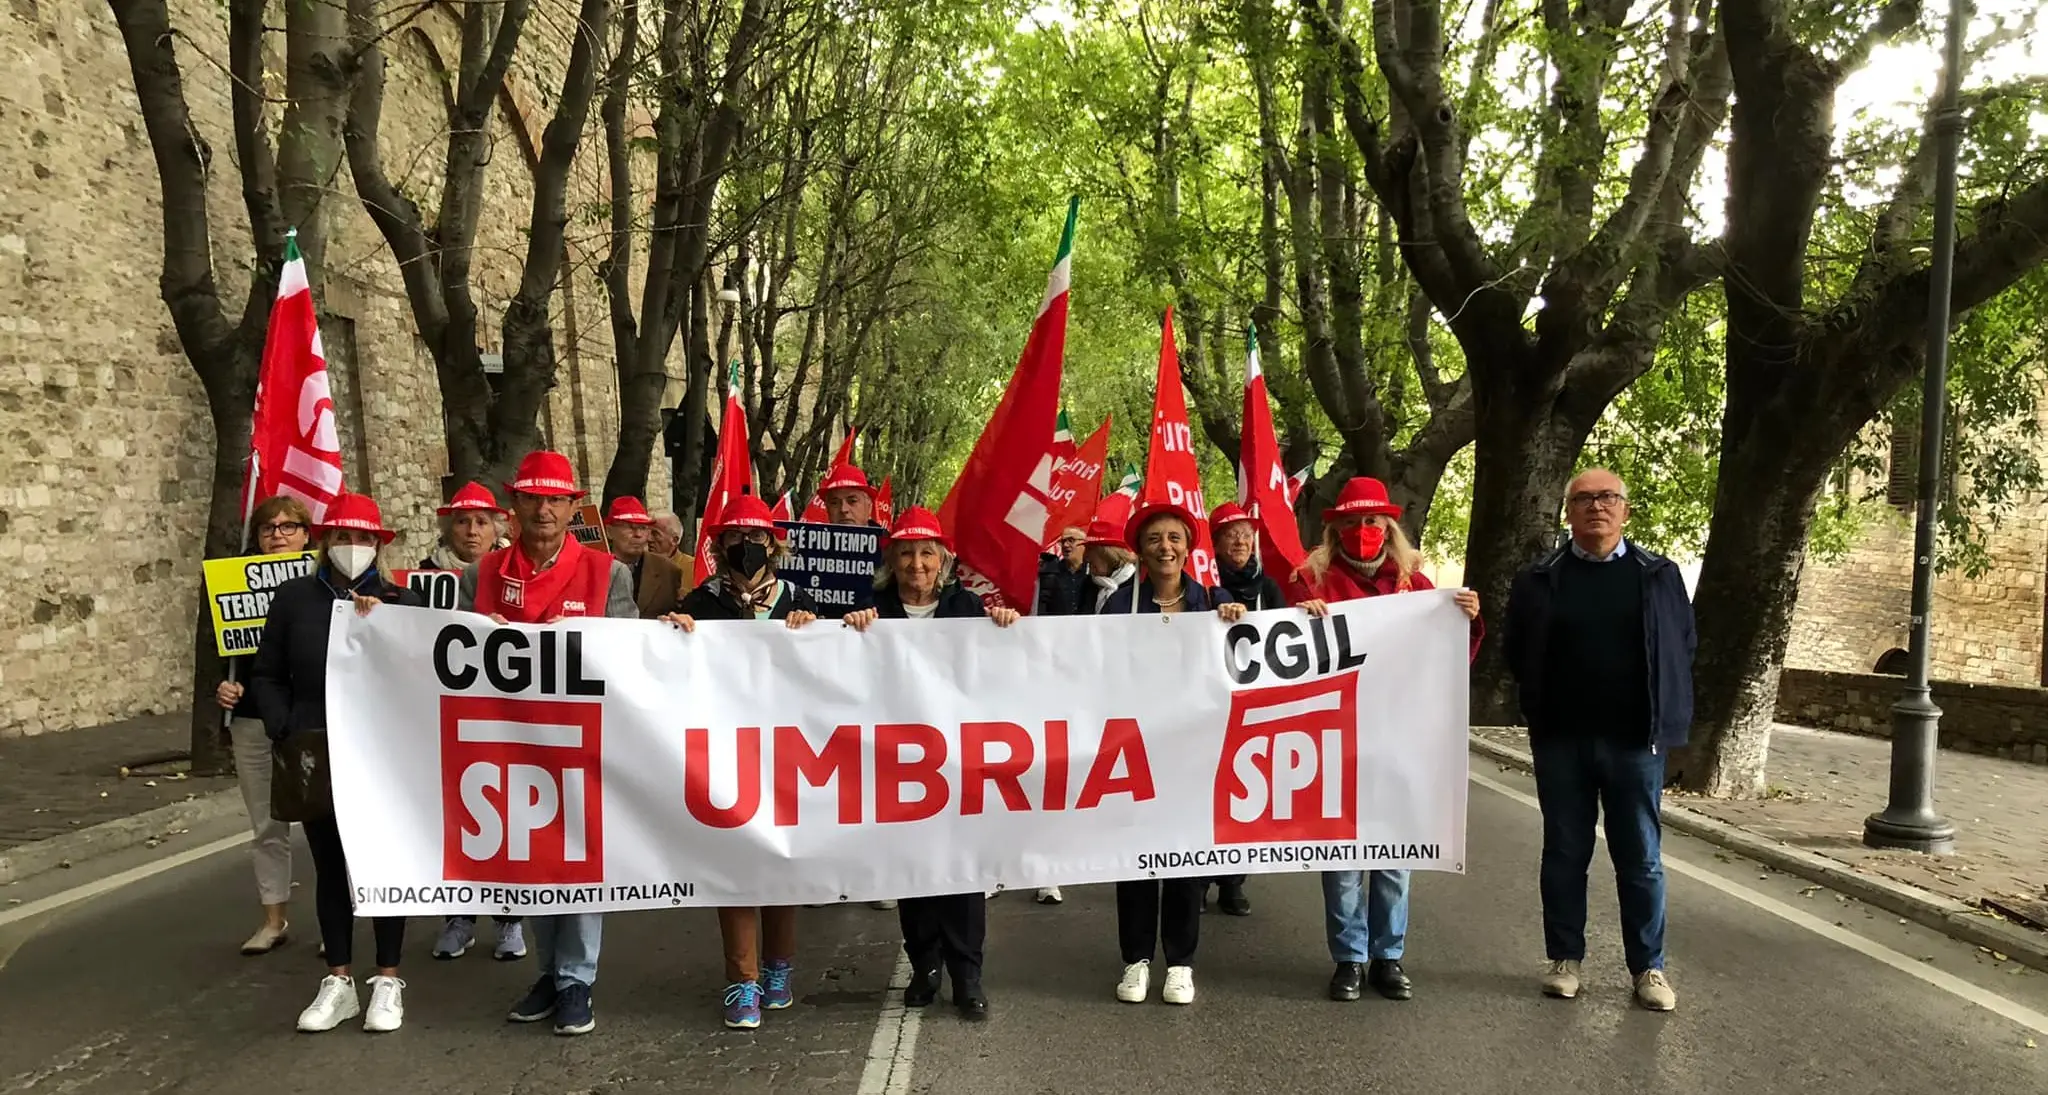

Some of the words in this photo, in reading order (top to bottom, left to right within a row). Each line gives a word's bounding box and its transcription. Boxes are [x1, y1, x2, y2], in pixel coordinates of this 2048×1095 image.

[808, 528, 831, 551] PIÙ
[833, 532, 877, 554] TEMPO
[807, 557, 875, 576] PUBBLICA
[811, 575, 820, 587] e
[504, 585, 521, 605] SPI
[563, 600, 586, 611] CGIL
[433, 624, 605, 696] CGIL
[1224, 614, 1367, 685] CGIL
[684, 718, 1156, 830] UMBRIA
[1229, 728, 1343, 823] SPI
[460, 761, 586, 862] SPI
[1137, 849, 1242, 870] SINDACATO
[1248, 844, 1357, 864] PENSIONATI
[1363, 843, 1440, 861] ITALIANI
[357, 885, 474, 905] SINDACATO
[480, 887, 603, 906] PENSIONATI
[610, 882, 695, 901] ITALIANI
